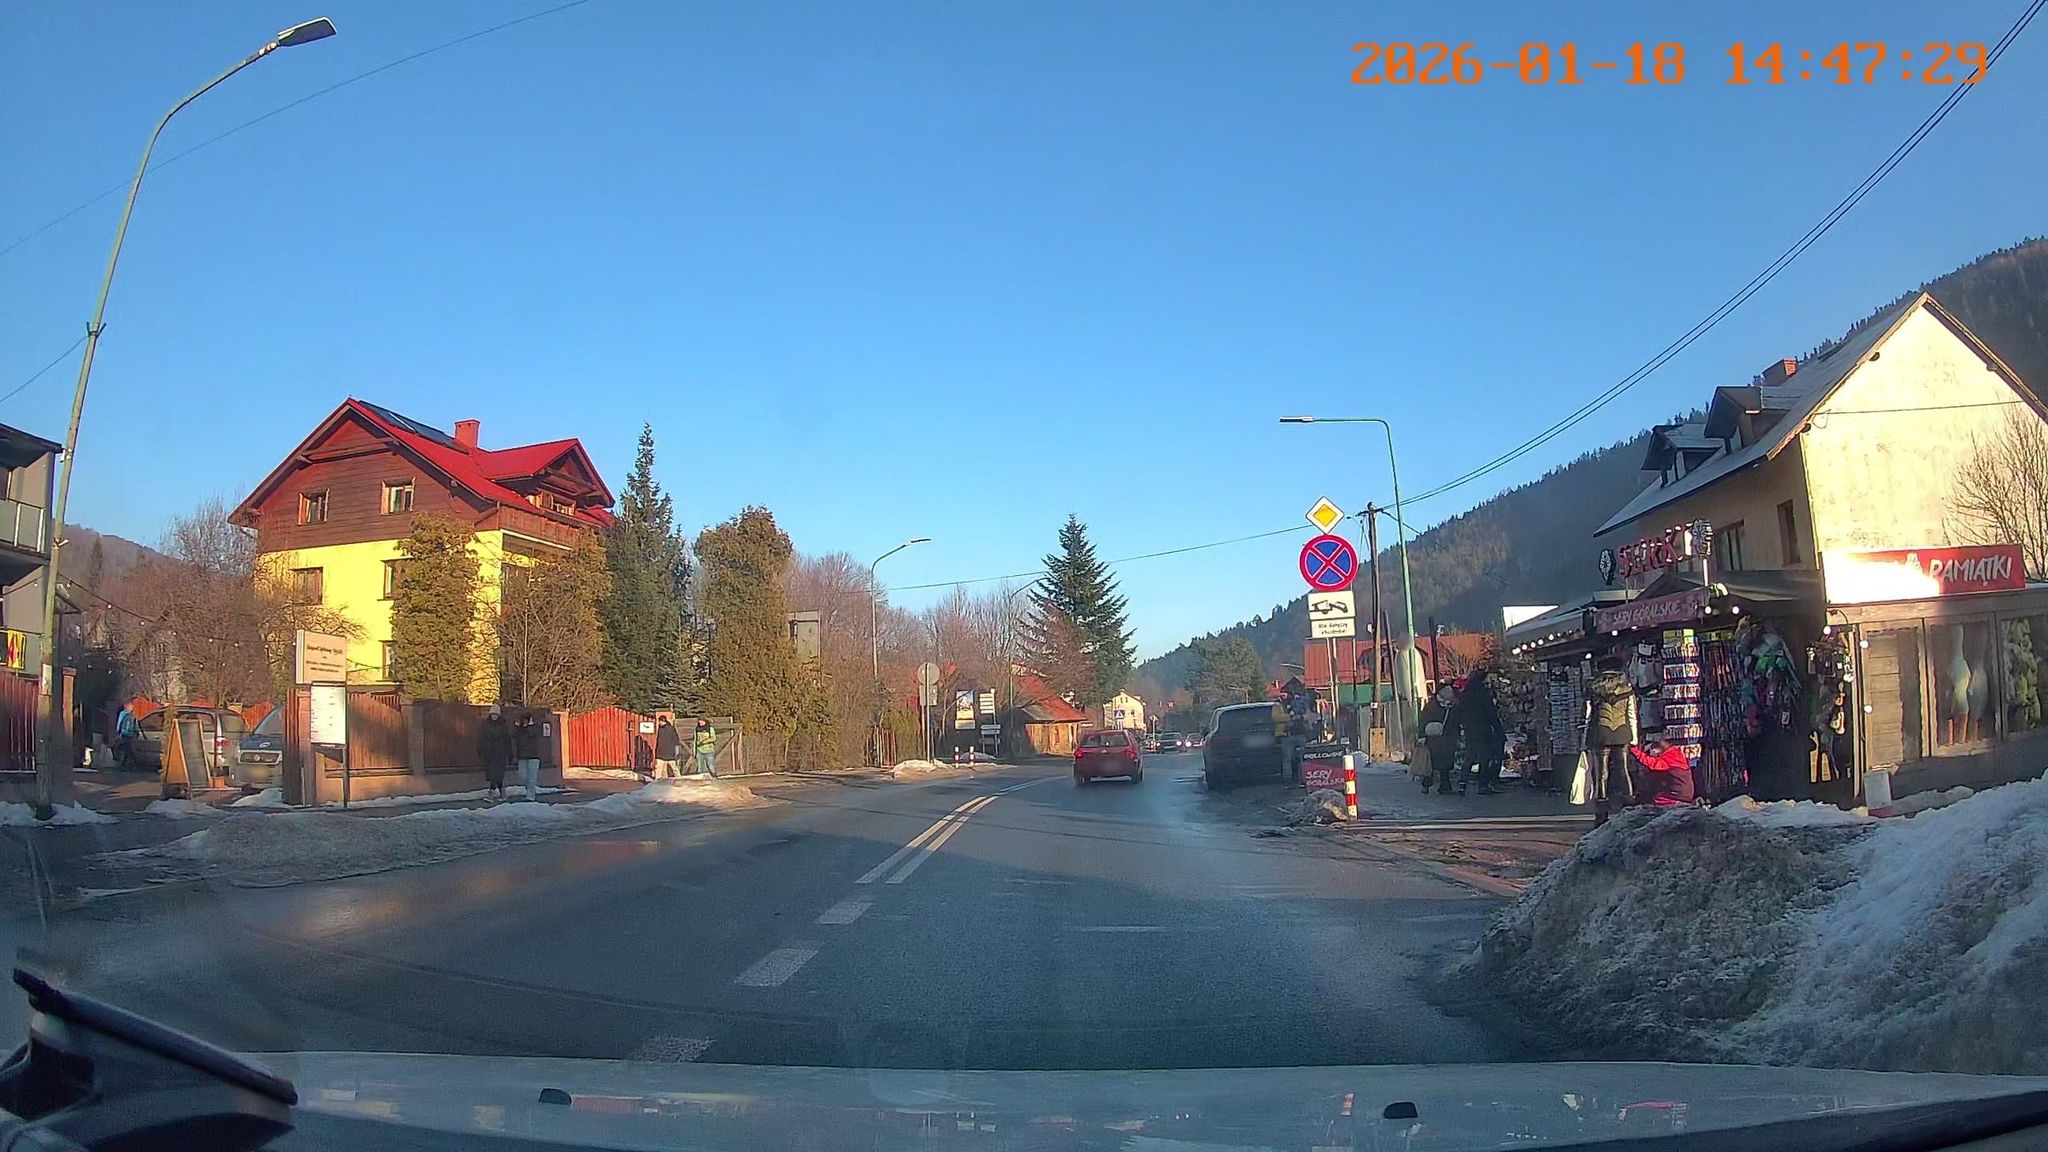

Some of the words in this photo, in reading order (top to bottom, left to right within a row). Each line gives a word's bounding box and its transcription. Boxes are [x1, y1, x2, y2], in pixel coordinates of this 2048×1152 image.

[1929, 555, 2012, 586] PAMIĄTKI
[1612, 609, 1632, 626] SERY
[1632, 600, 1681, 620] GÓRALSKIE
[1305, 769, 1332, 780] SERY
